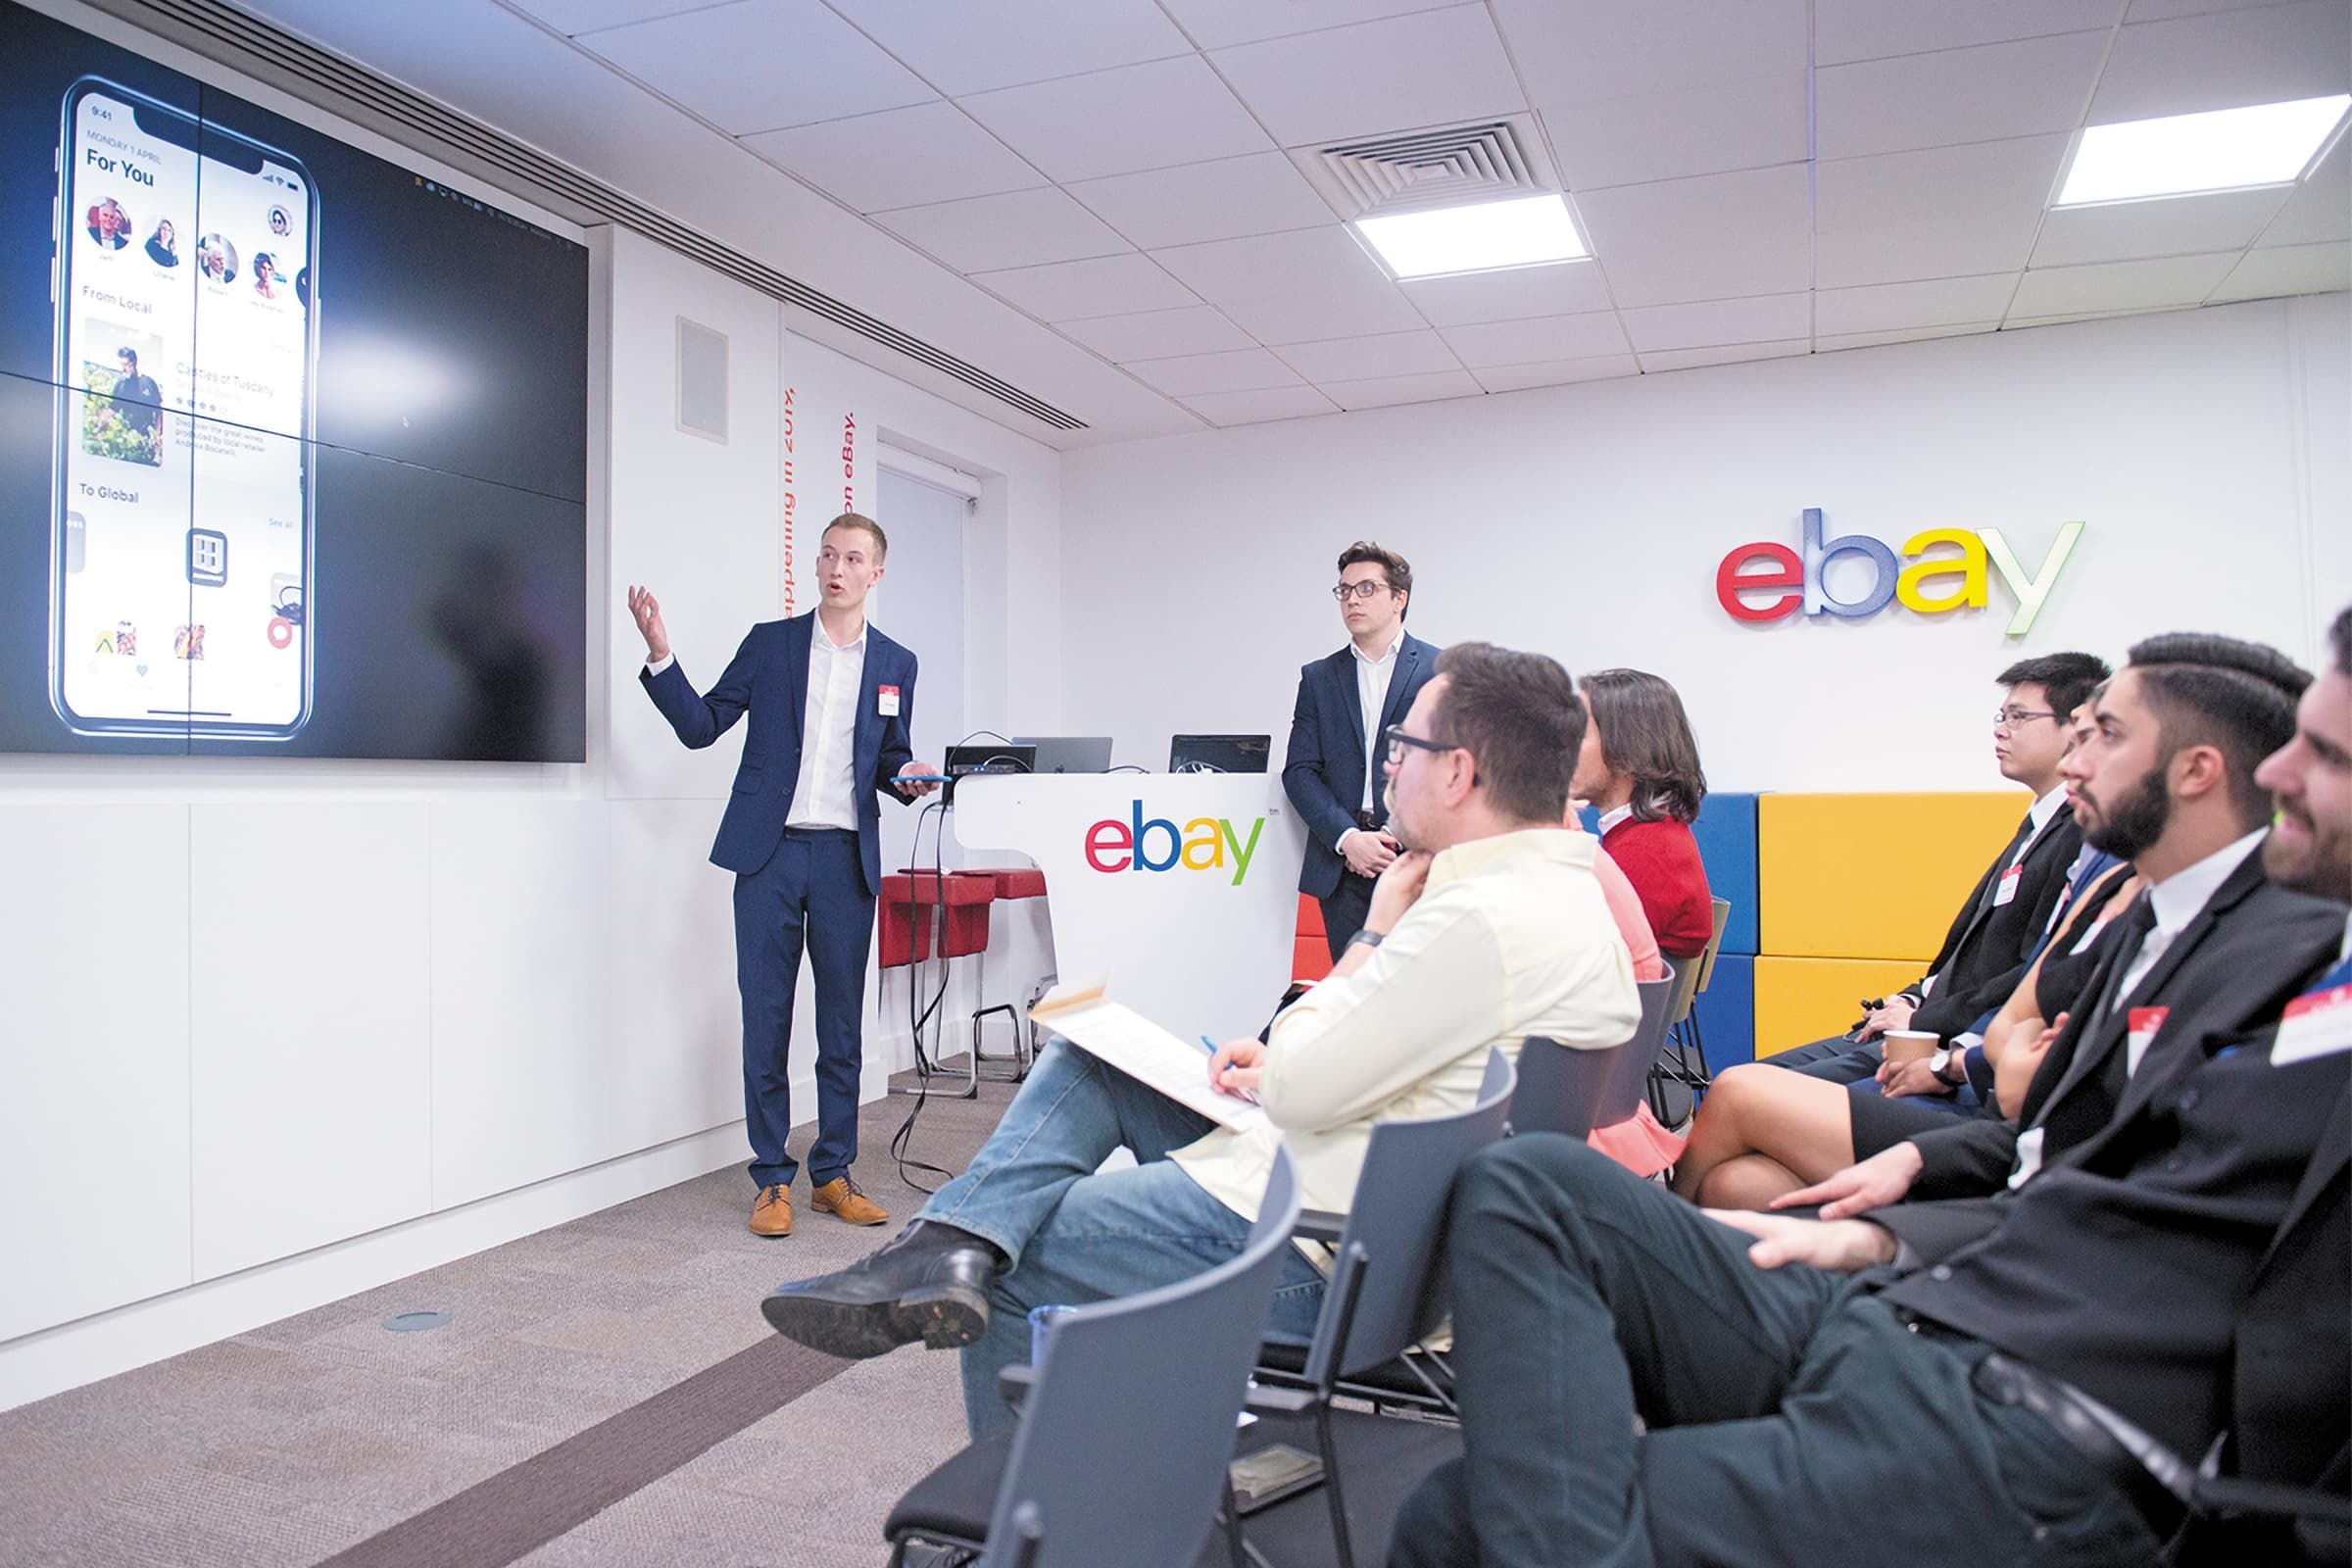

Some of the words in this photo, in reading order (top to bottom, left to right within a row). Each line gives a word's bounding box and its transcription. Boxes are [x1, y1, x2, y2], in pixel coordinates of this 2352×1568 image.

[91, 105, 112, 121] 9:41
[86, 129, 127, 151] MONDAY
[87, 148, 118, 172] For
[122, 159, 154, 186] You
[82, 284, 117, 304] From
[119, 296, 153, 315] Local
[841, 412, 857, 479] eBay.
[79, 482, 94, 496] To
[97, 485, 139, 504] Global
[784, 491, 797, 619] appening
[1716, 508, 2086, 636] ebay
[1085, 799, 1266, 886] ebay
